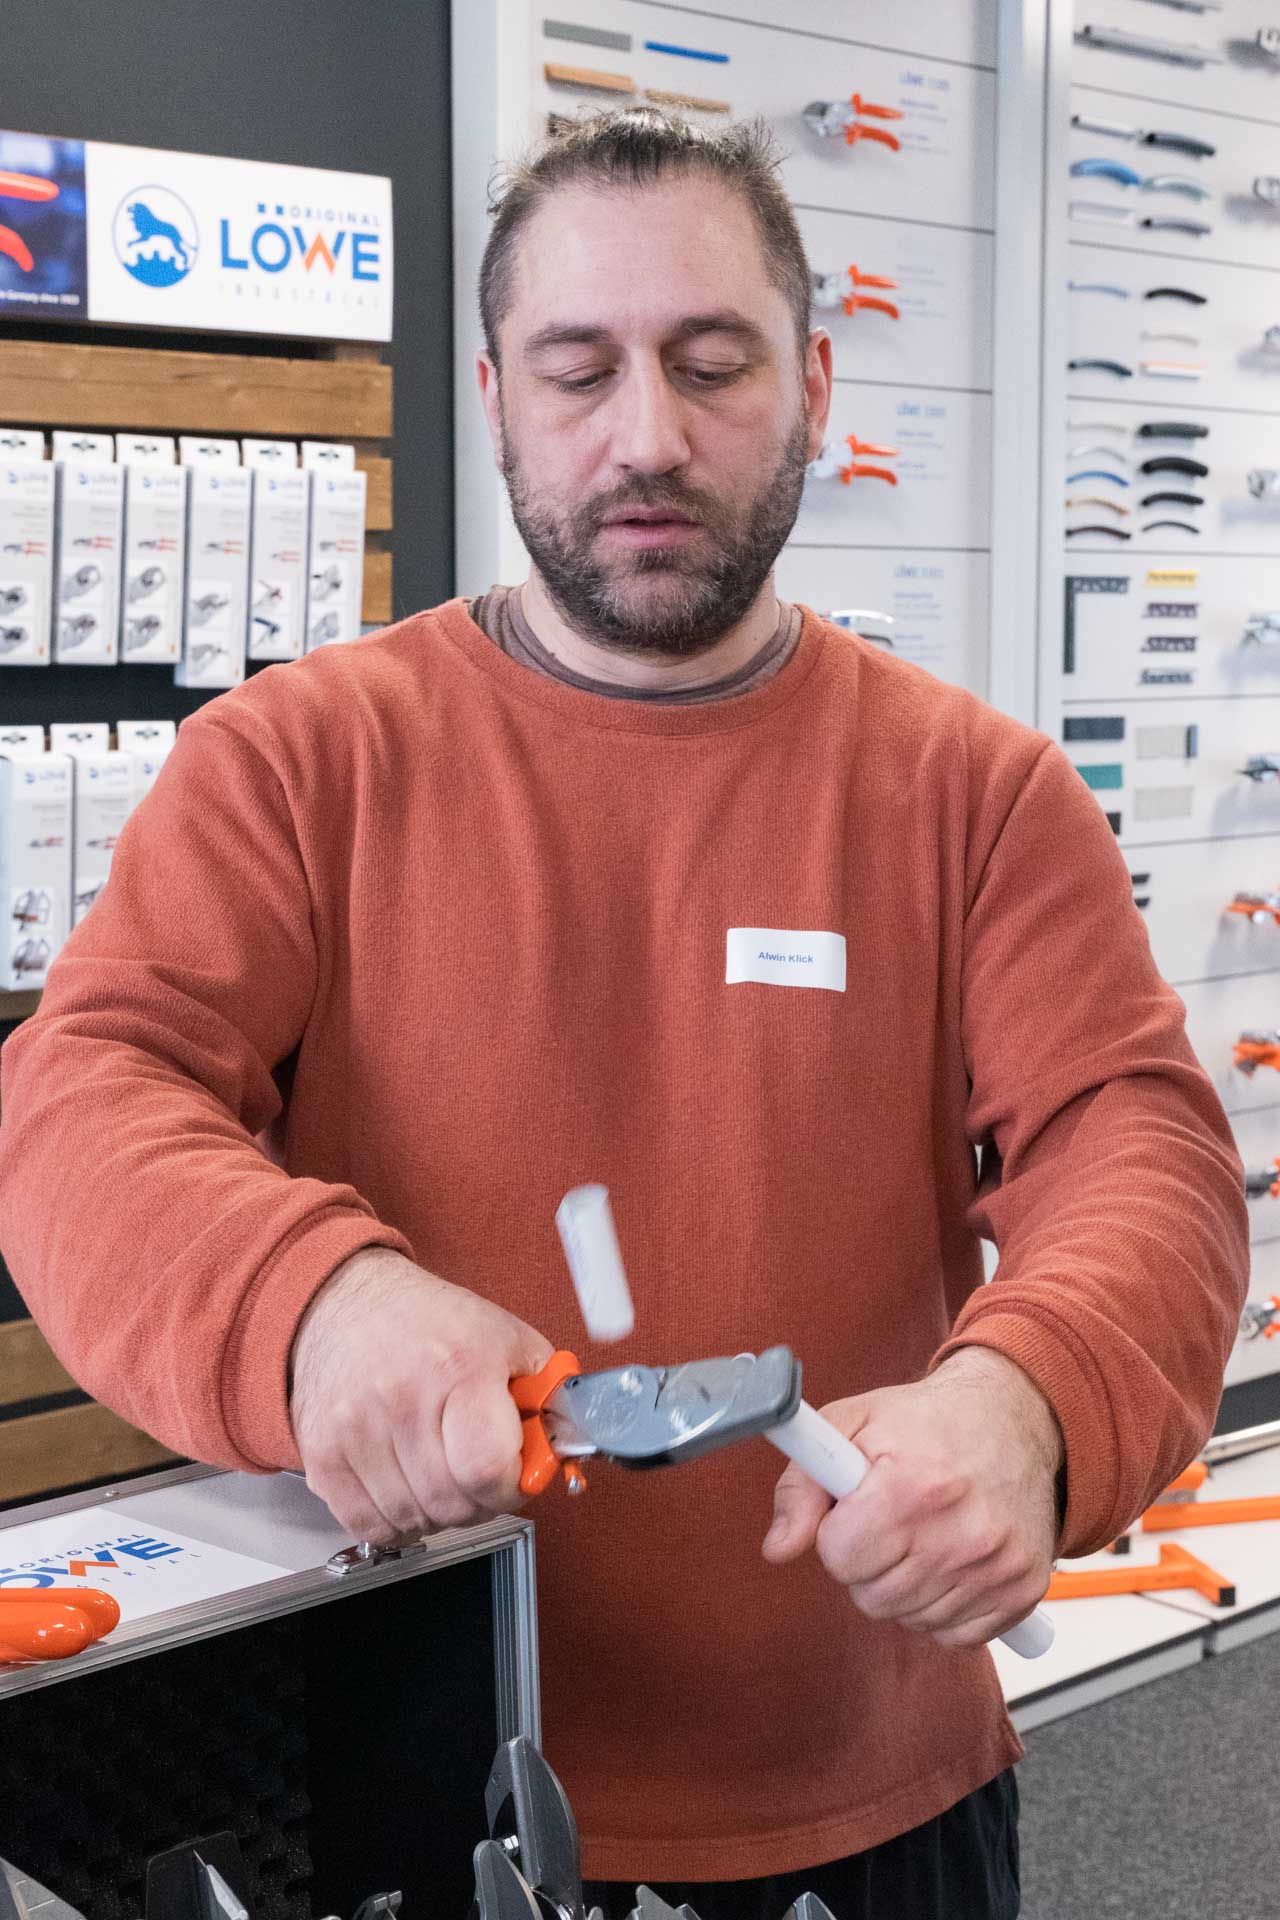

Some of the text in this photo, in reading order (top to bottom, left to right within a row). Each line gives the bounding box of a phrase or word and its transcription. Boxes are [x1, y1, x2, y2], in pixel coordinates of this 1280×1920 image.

[289, 205, 380, 226] ORIGINAL
[758, 951, 815, 964] Alwin Klick
[19, 1533, 145, 1569] ORIGINAL
